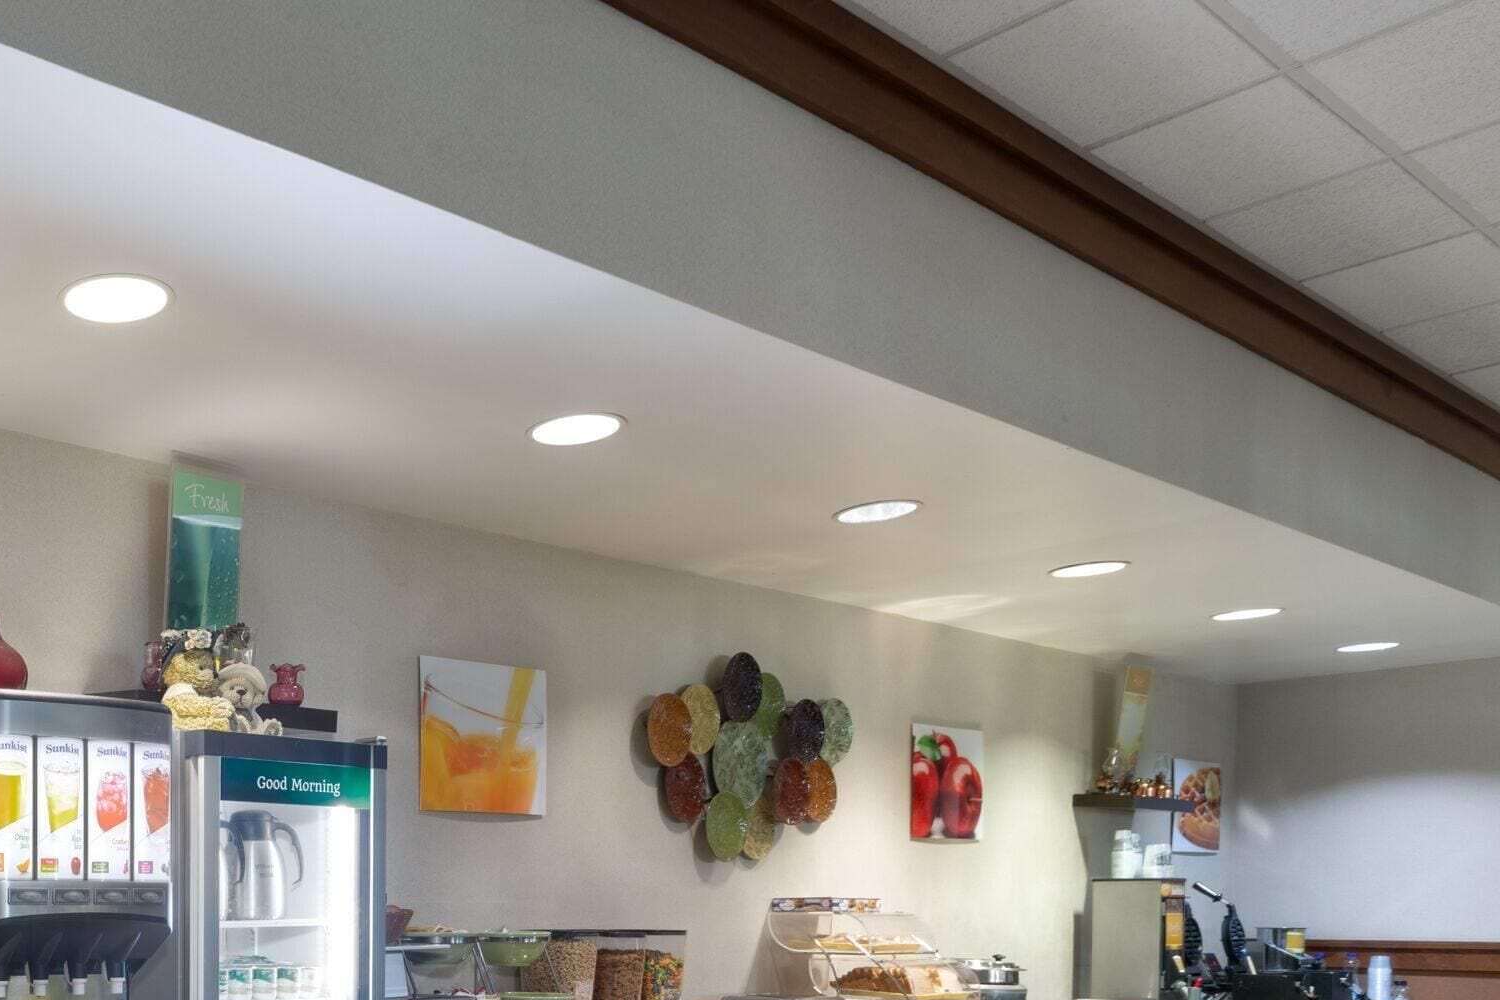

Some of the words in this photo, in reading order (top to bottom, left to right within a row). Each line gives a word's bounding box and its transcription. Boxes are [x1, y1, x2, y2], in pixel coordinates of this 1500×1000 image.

[184, 483, 230, 513] Fresh
[257, 776, 287, 790] Good
[291, 778, 340, 797] Morning
